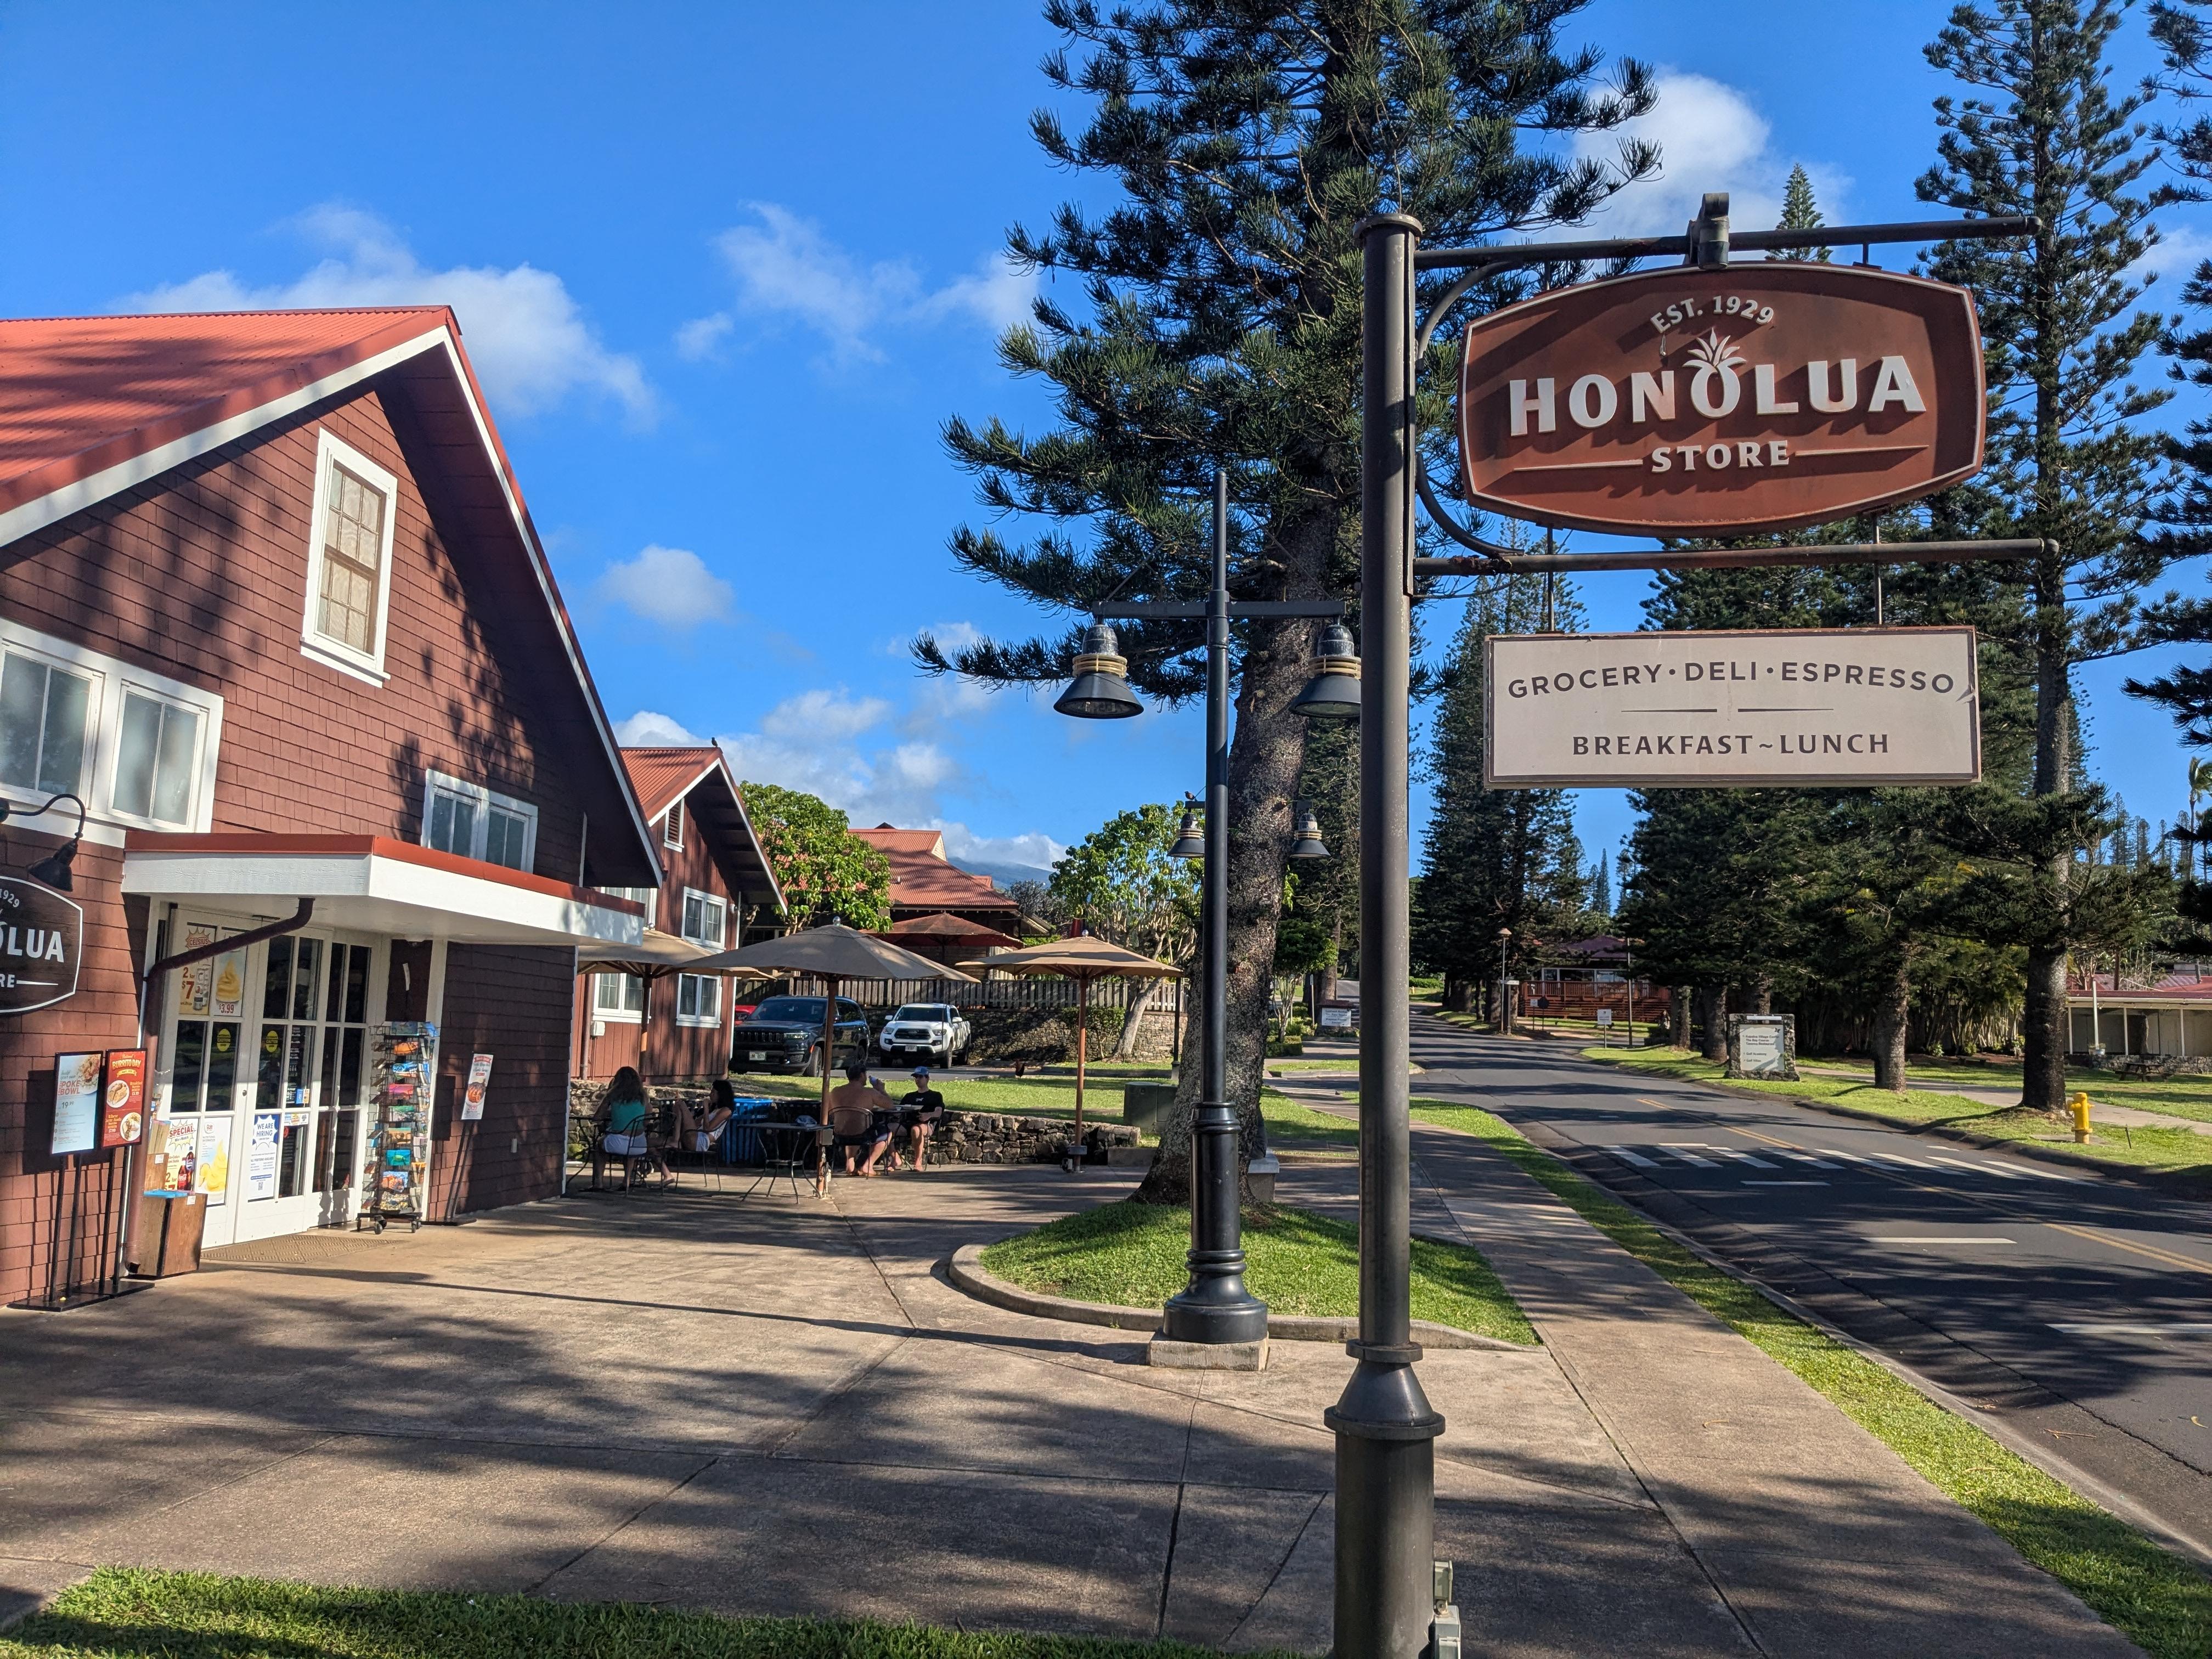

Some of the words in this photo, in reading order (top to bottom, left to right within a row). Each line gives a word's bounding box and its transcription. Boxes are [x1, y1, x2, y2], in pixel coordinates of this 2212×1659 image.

[1650, 298, 1703, 334] EST.
[1713, 295, 1774, 325] 1929
[1509, 352, 1927, 437] HONOLUA
[1651, 439, 1790, 473] STORE
[1508, 663, 1663, 699] GROCERY
[1685, 661, 1756, 682] DELI
[1781, 661, 1954, 694] ESPRESSO
[1572, 734, 1754, 756] BREAKFAST
[1779, 733, 1889, 755] LUNCH
[189, 938, 208, 946] CELSIUS
[183, 967, 189, 978] 2
[182, 980, 195, 1000] $7
[219, 1003, 235, 1014] $3.99
[112, 1059, 132, 1070] BURRITO
[132, 1059, 142, 1068] DAY
[60, 1087, 80, 1096] BOWL
[169, 1125, 194, 1138] SPECIAL
